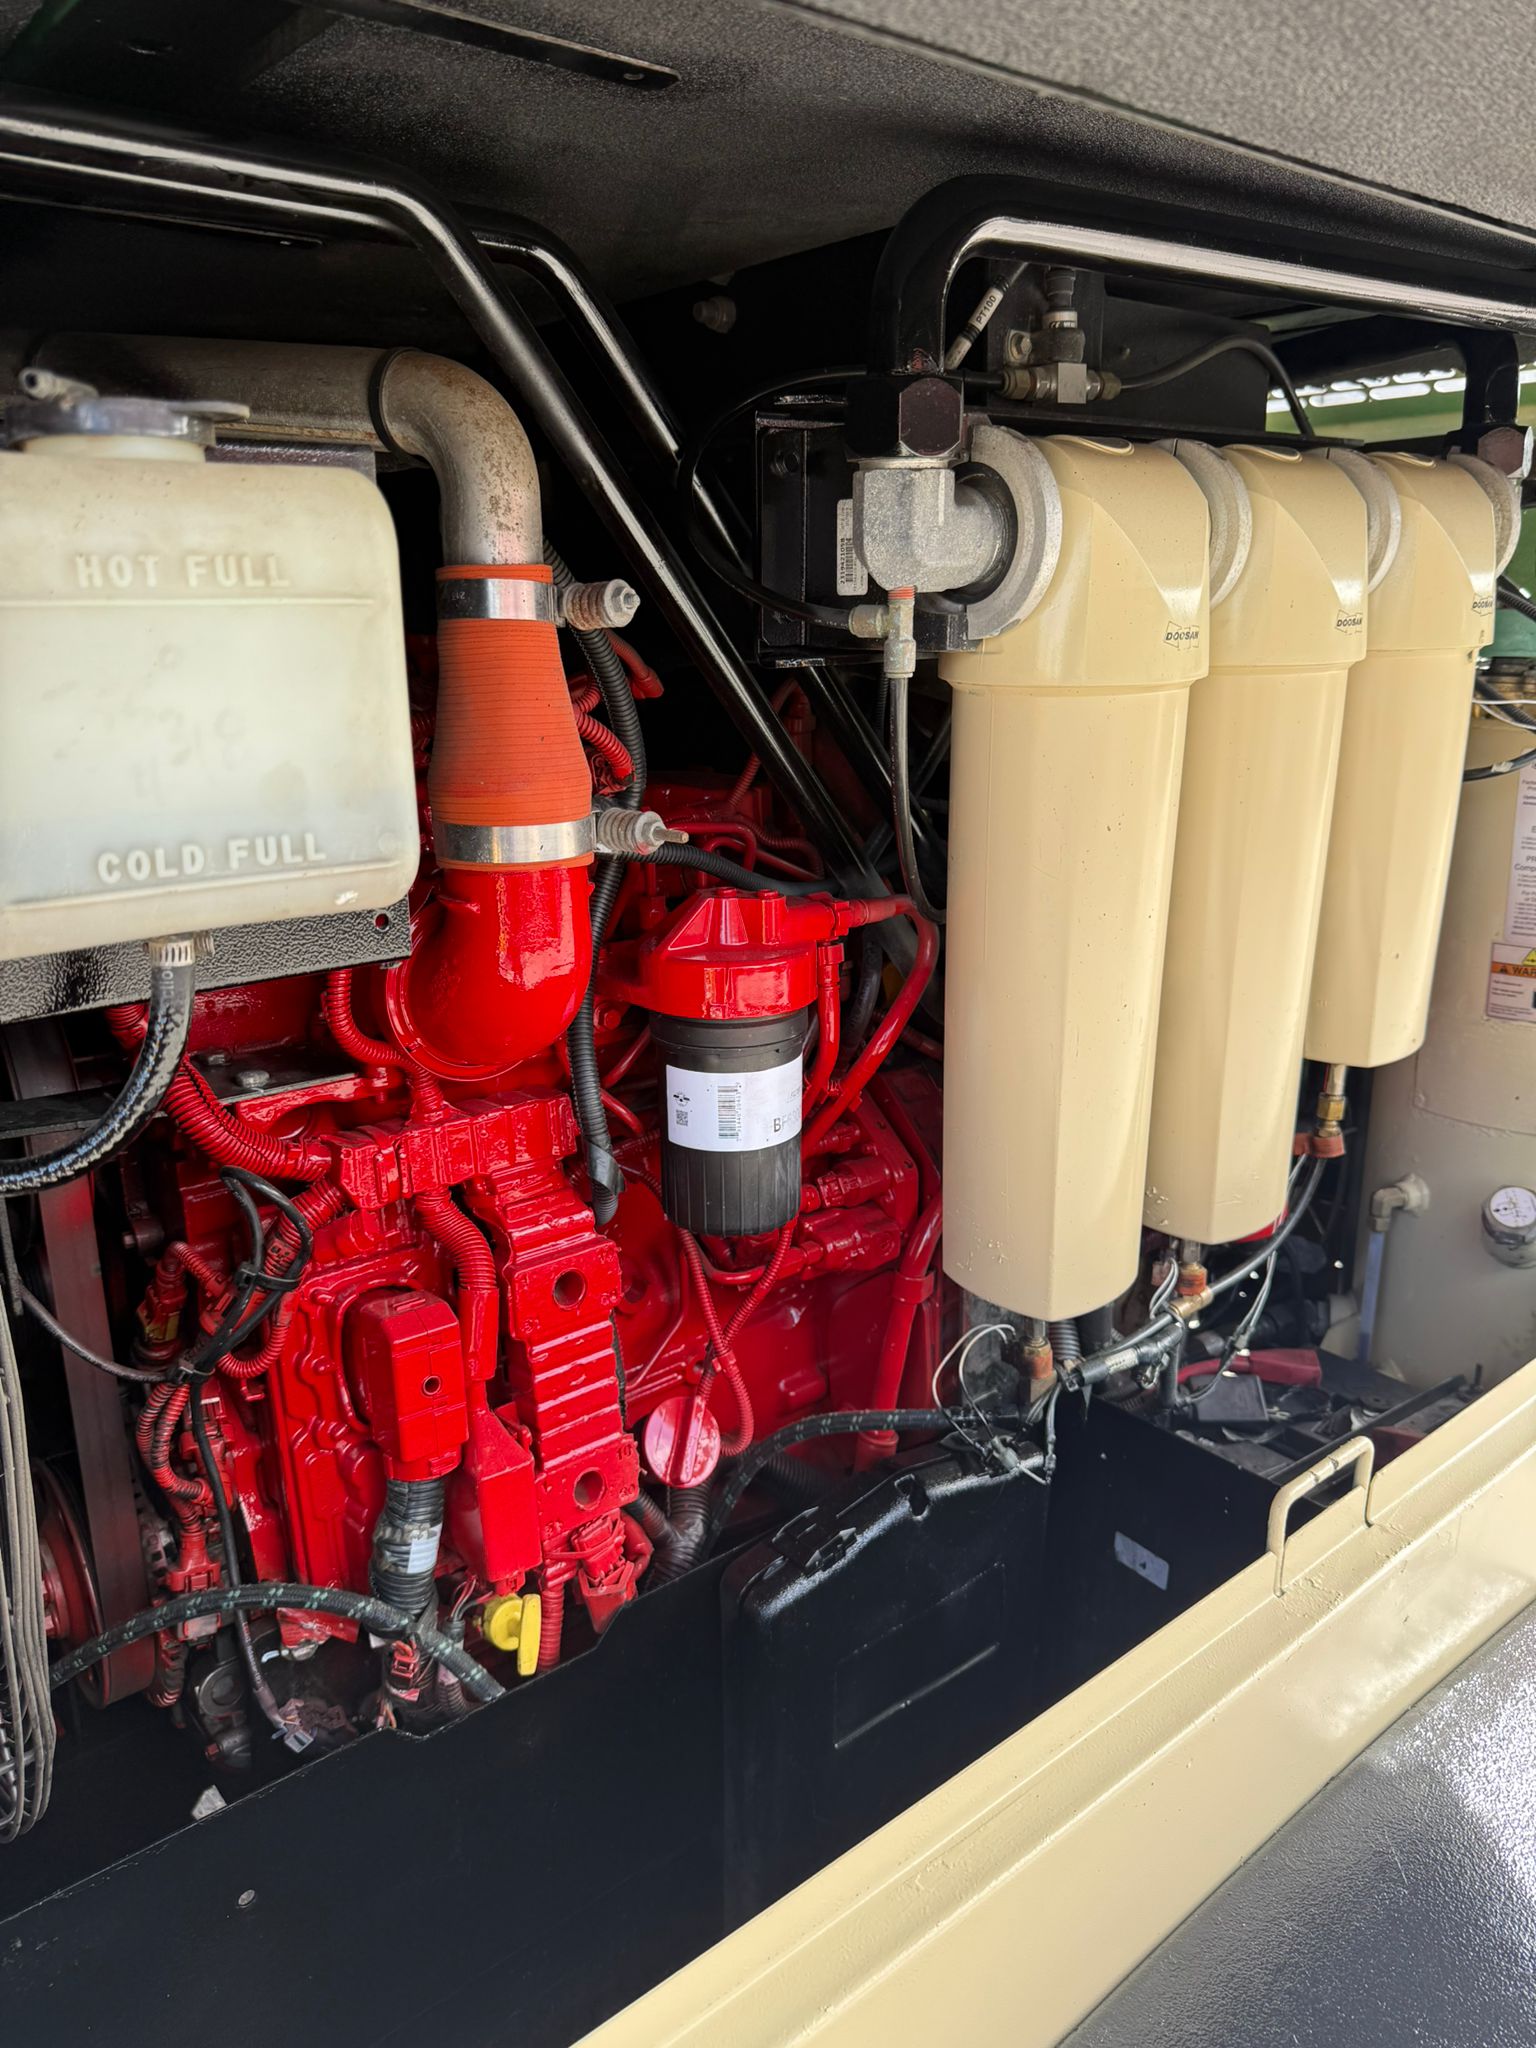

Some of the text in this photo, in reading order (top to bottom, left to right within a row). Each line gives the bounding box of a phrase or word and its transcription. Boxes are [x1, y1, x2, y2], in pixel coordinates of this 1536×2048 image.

[976, 295, 997, 325] PT100
[75, 554, 290, 589] HOT FULL
[1165, 631, 1200, 641] DOOSAN
[97, 832, 327, 885] COLD FULL
